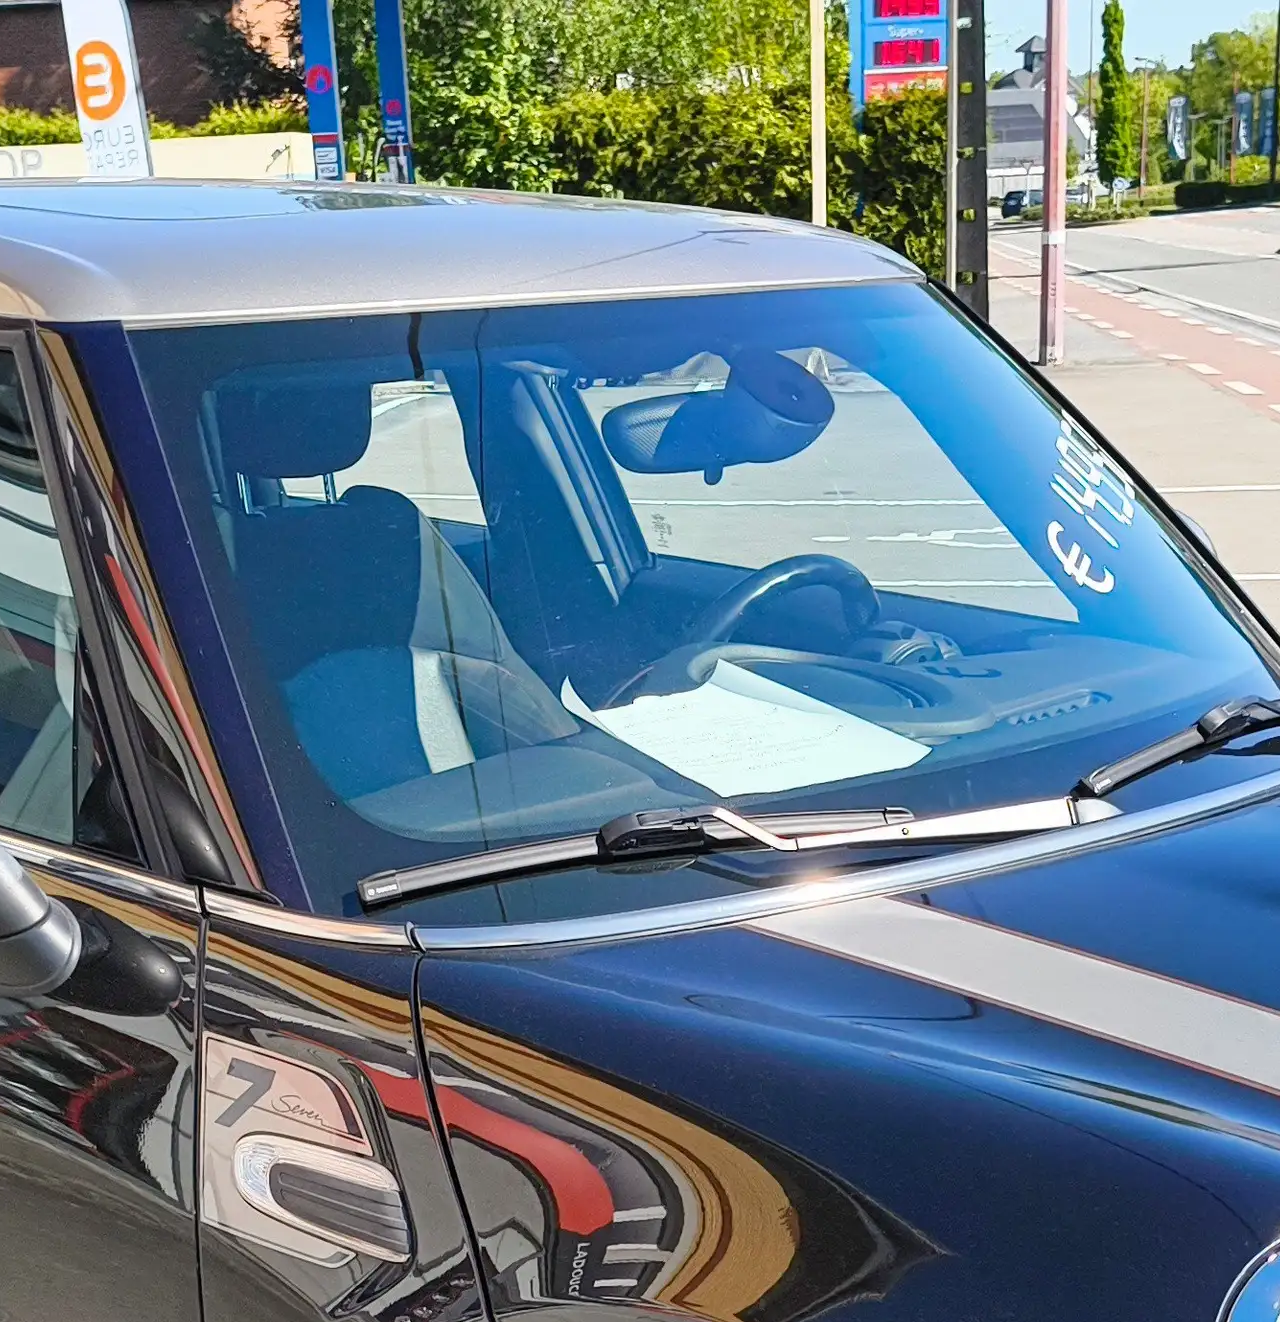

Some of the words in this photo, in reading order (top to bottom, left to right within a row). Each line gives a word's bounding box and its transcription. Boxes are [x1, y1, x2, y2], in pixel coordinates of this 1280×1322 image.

[1046, 519, 1116, 594] €
[214, 1056, 277, 1128] 7
[270, 1093, 332, 1128] Seven
